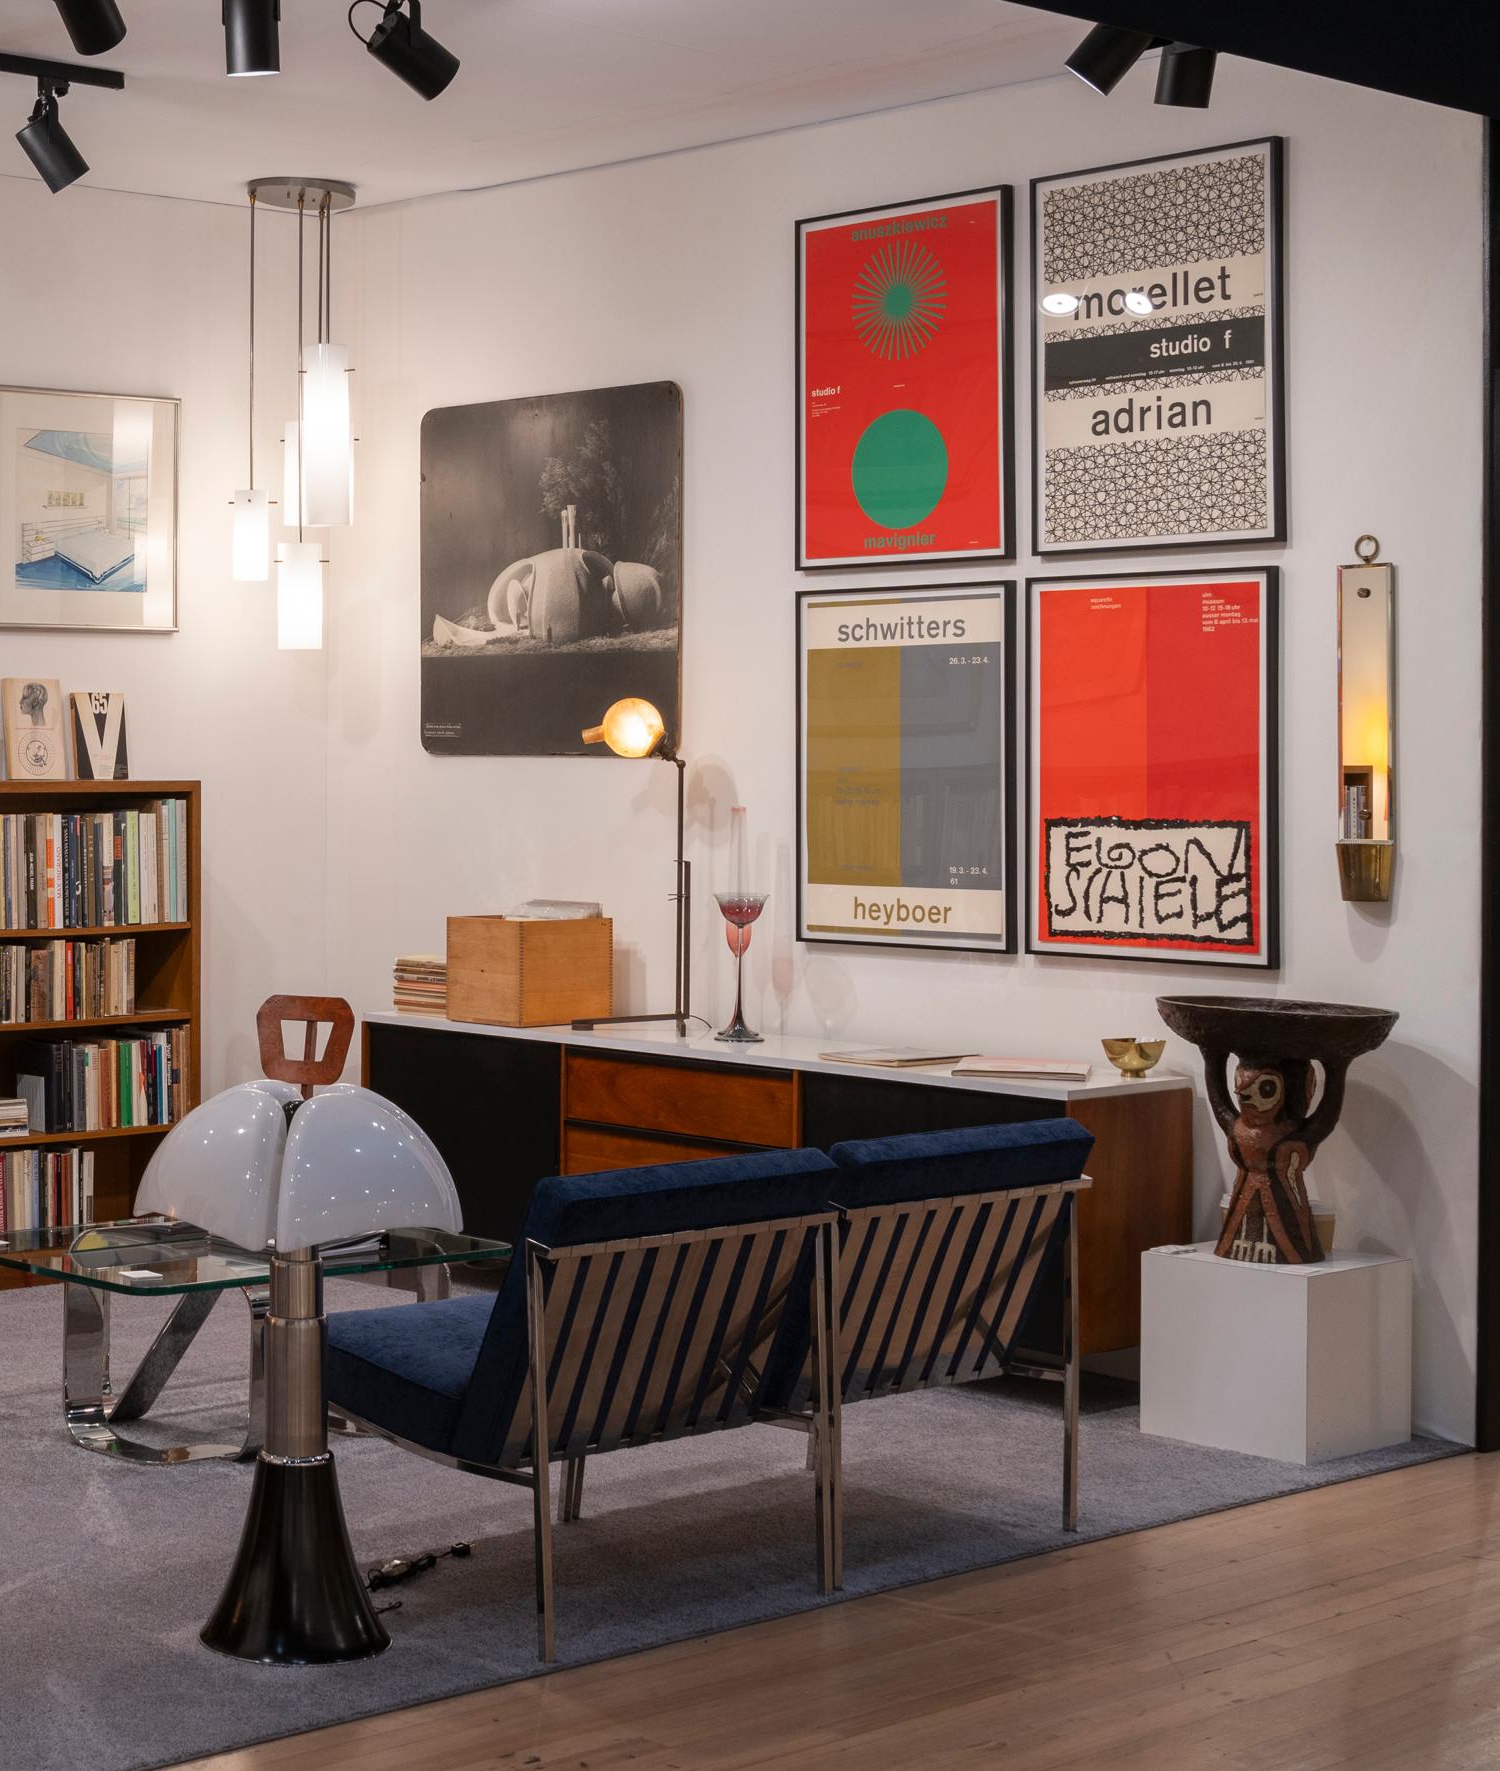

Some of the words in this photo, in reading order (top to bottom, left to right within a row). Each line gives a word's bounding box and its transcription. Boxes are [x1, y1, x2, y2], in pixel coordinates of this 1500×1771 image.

[851, 214, 948, 242] anuszkiewicz
[1074, 266, 1231, 321] moellet
[1149, 334, 1211, 359] studio
[1223, 329, 1232, 349] f
[811, 386, 836, 398] studio
[836, 385, 841, 395] f
[1091, 395, 1212, 437] adrian
[863, 531, 936, 551] mavignier
[836, 615, 967, 643] schwitters
[91, 692, 109, 715] 65
[853, 896, 952, 926] heyboer
